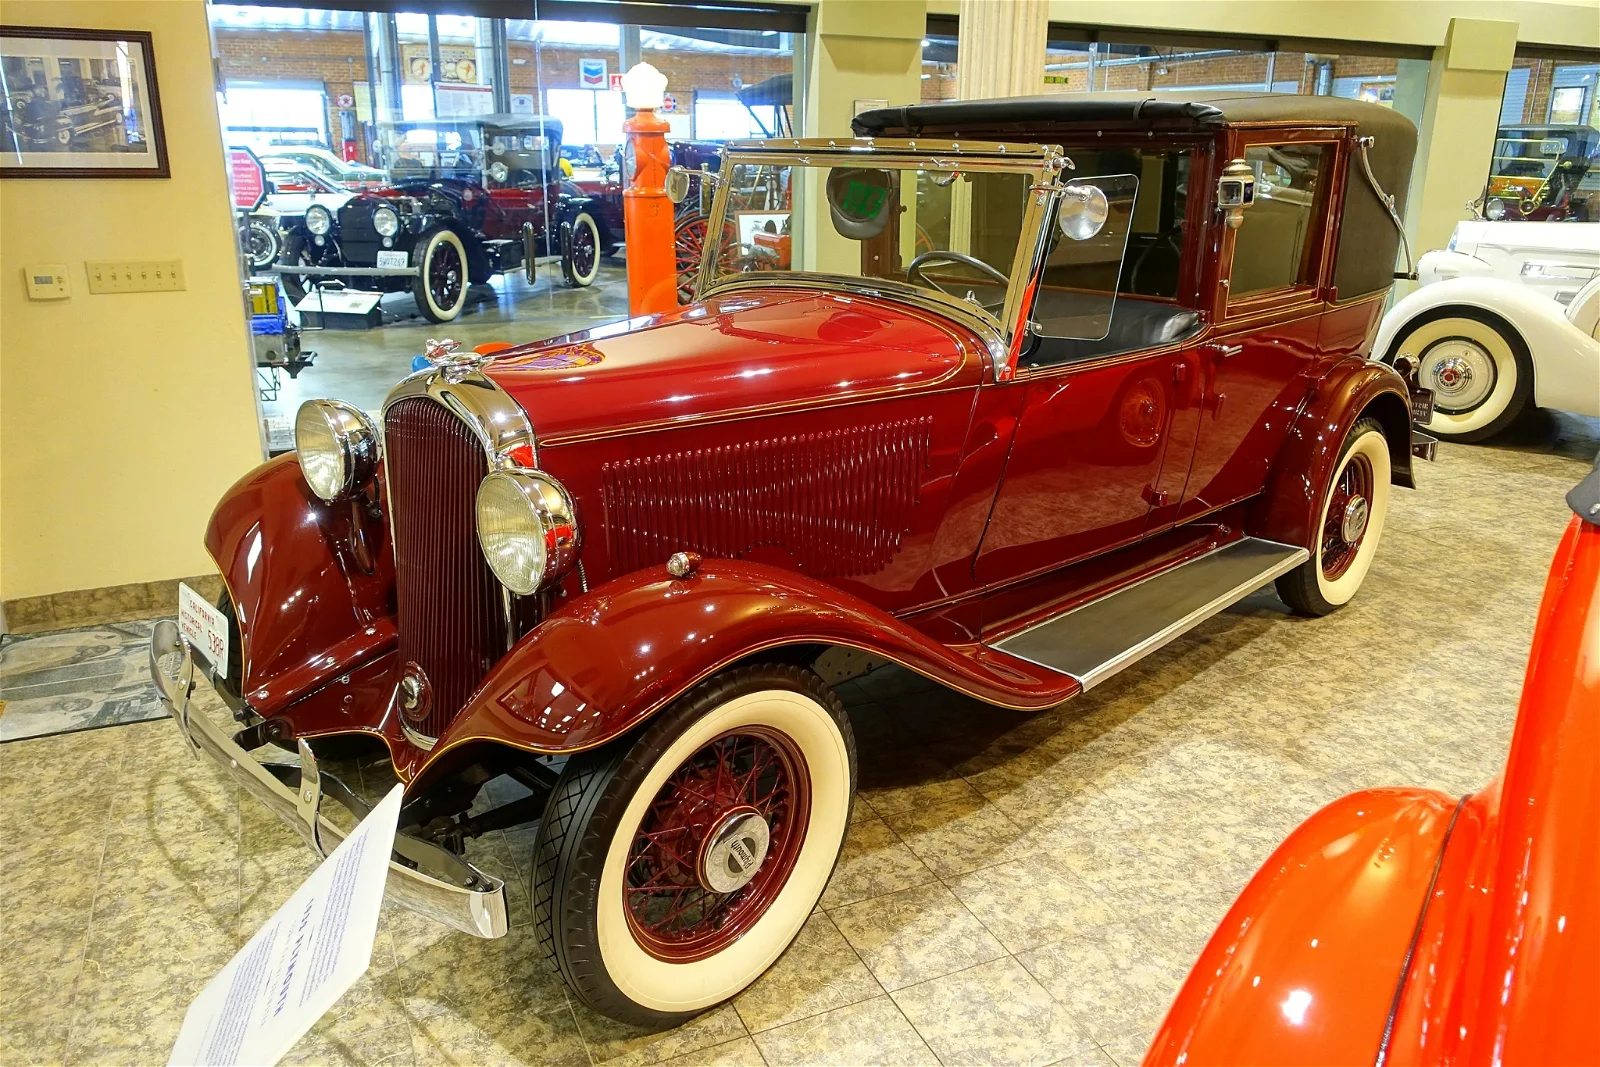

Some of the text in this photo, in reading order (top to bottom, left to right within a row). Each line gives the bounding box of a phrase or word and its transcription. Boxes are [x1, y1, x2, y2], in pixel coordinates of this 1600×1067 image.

[181, 610, 203, 633] HISTORICAL
[190, 600, 215, 625] CALIFORNIA
[181, 622, 197, 640] VEHICLE
[731, 840, 754, 870] Plymouth
[273, 933, 305, 1018] PLYMOUTH
